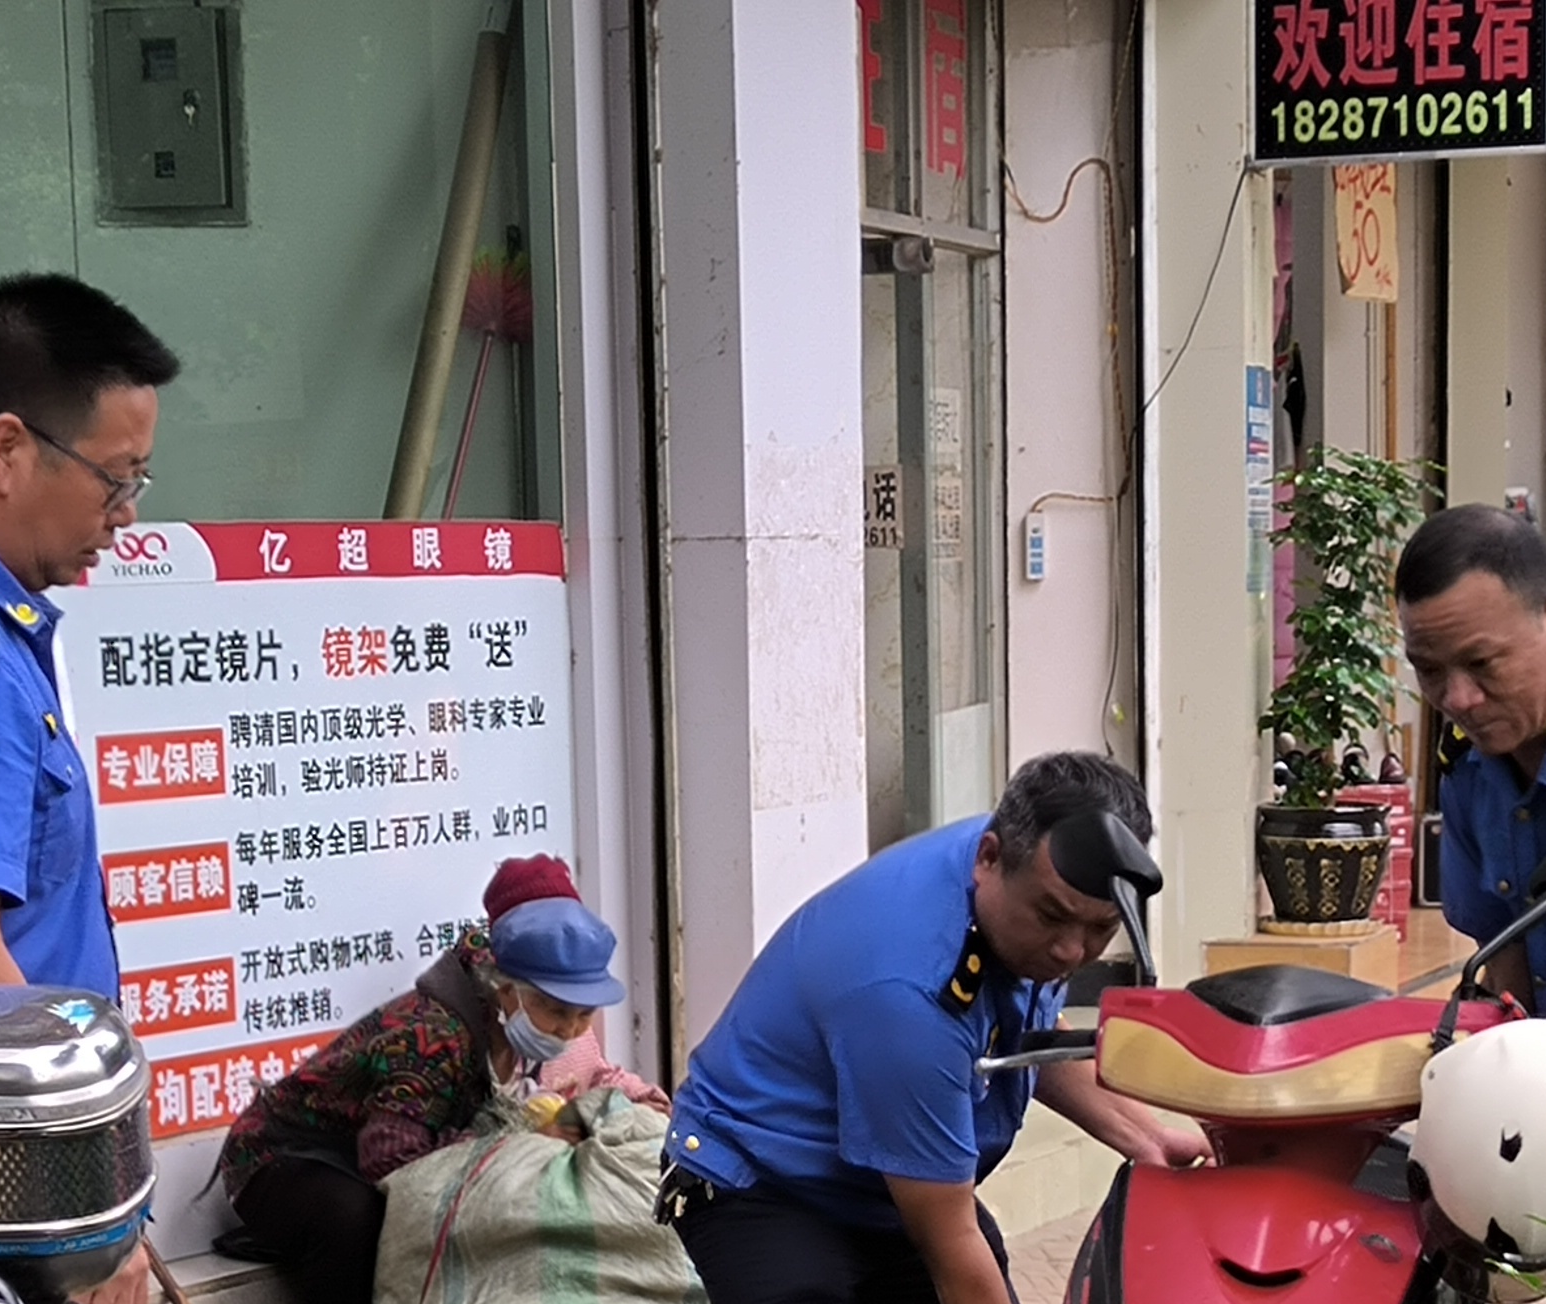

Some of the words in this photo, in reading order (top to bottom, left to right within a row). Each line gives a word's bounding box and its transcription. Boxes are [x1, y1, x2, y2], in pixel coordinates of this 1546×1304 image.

[1273, 0, 1532, 91] 欢迎住宿
[1271, 87, 1533, 142] 18287102611
[864, 472, 897, 521] 话
[111, 562, 173, 577] YICHAO
[259, 527, 513, 574] 亿超眼镜
[229, 695, 546, 748] 聘请国内顶级光学、眼科专家专业
[102, 740, 220, 790] 专业保障
[235, 804, 548, 867] 每年服务全国上百万人群，业内口
[107, 856, 225, 908] 顾客信赖
[237, 876, 317, 915] 碑一流。
[120, 968, 229, 1026] 服务承诺
[242, 987, 343, 1034] 传统推销。
